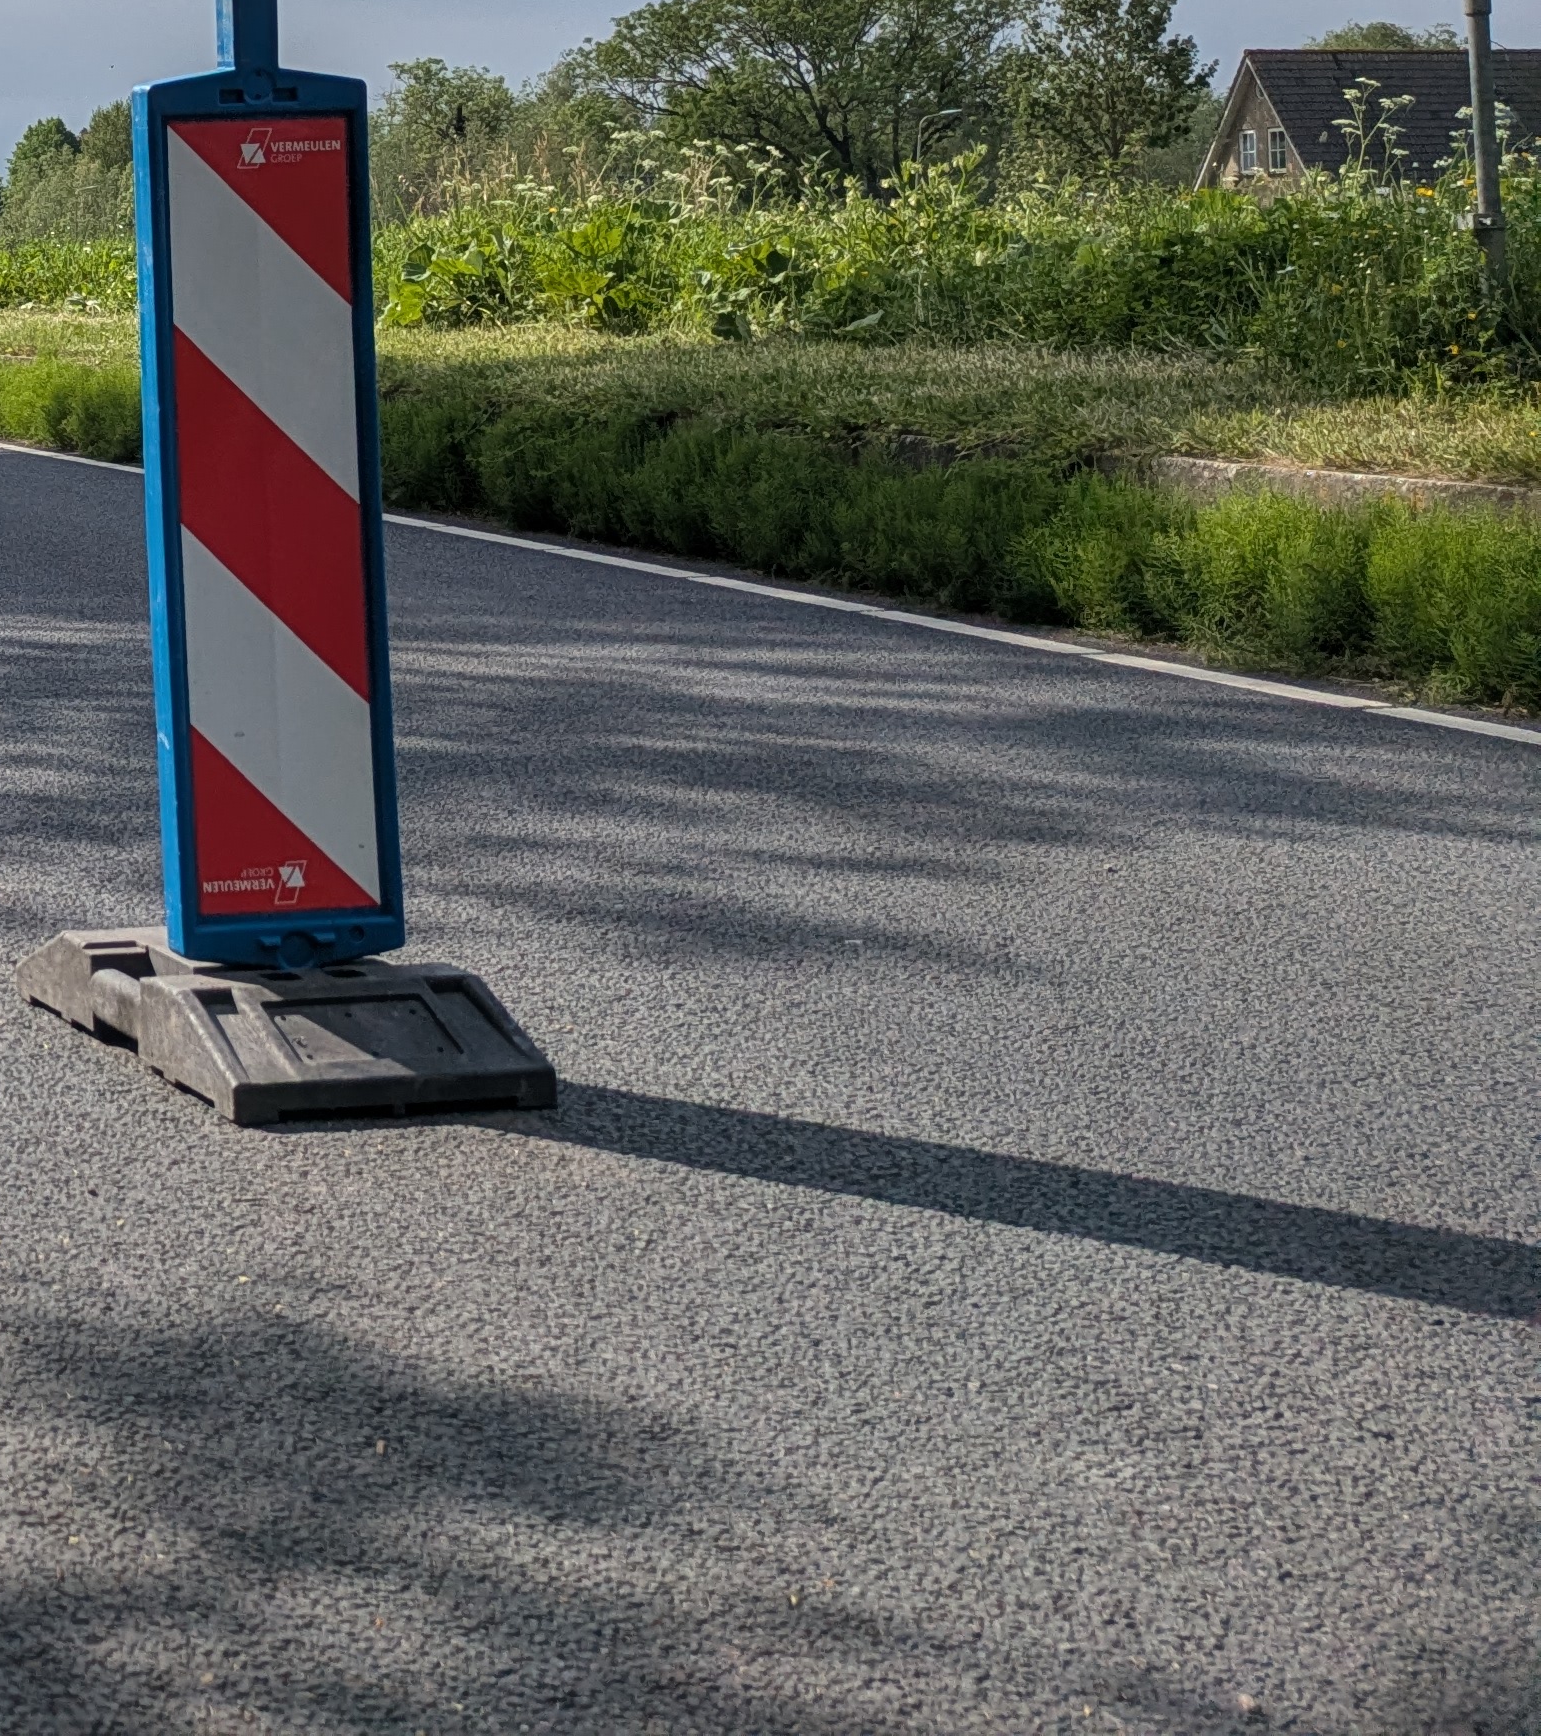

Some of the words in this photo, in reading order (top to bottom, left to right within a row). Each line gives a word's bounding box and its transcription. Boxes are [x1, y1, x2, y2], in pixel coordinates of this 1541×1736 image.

[270, 139, 341, 153] VERMEULEN
[270, 153, 303, 163] GROEP
[203, 878, 275, 893] VERMEULEN
